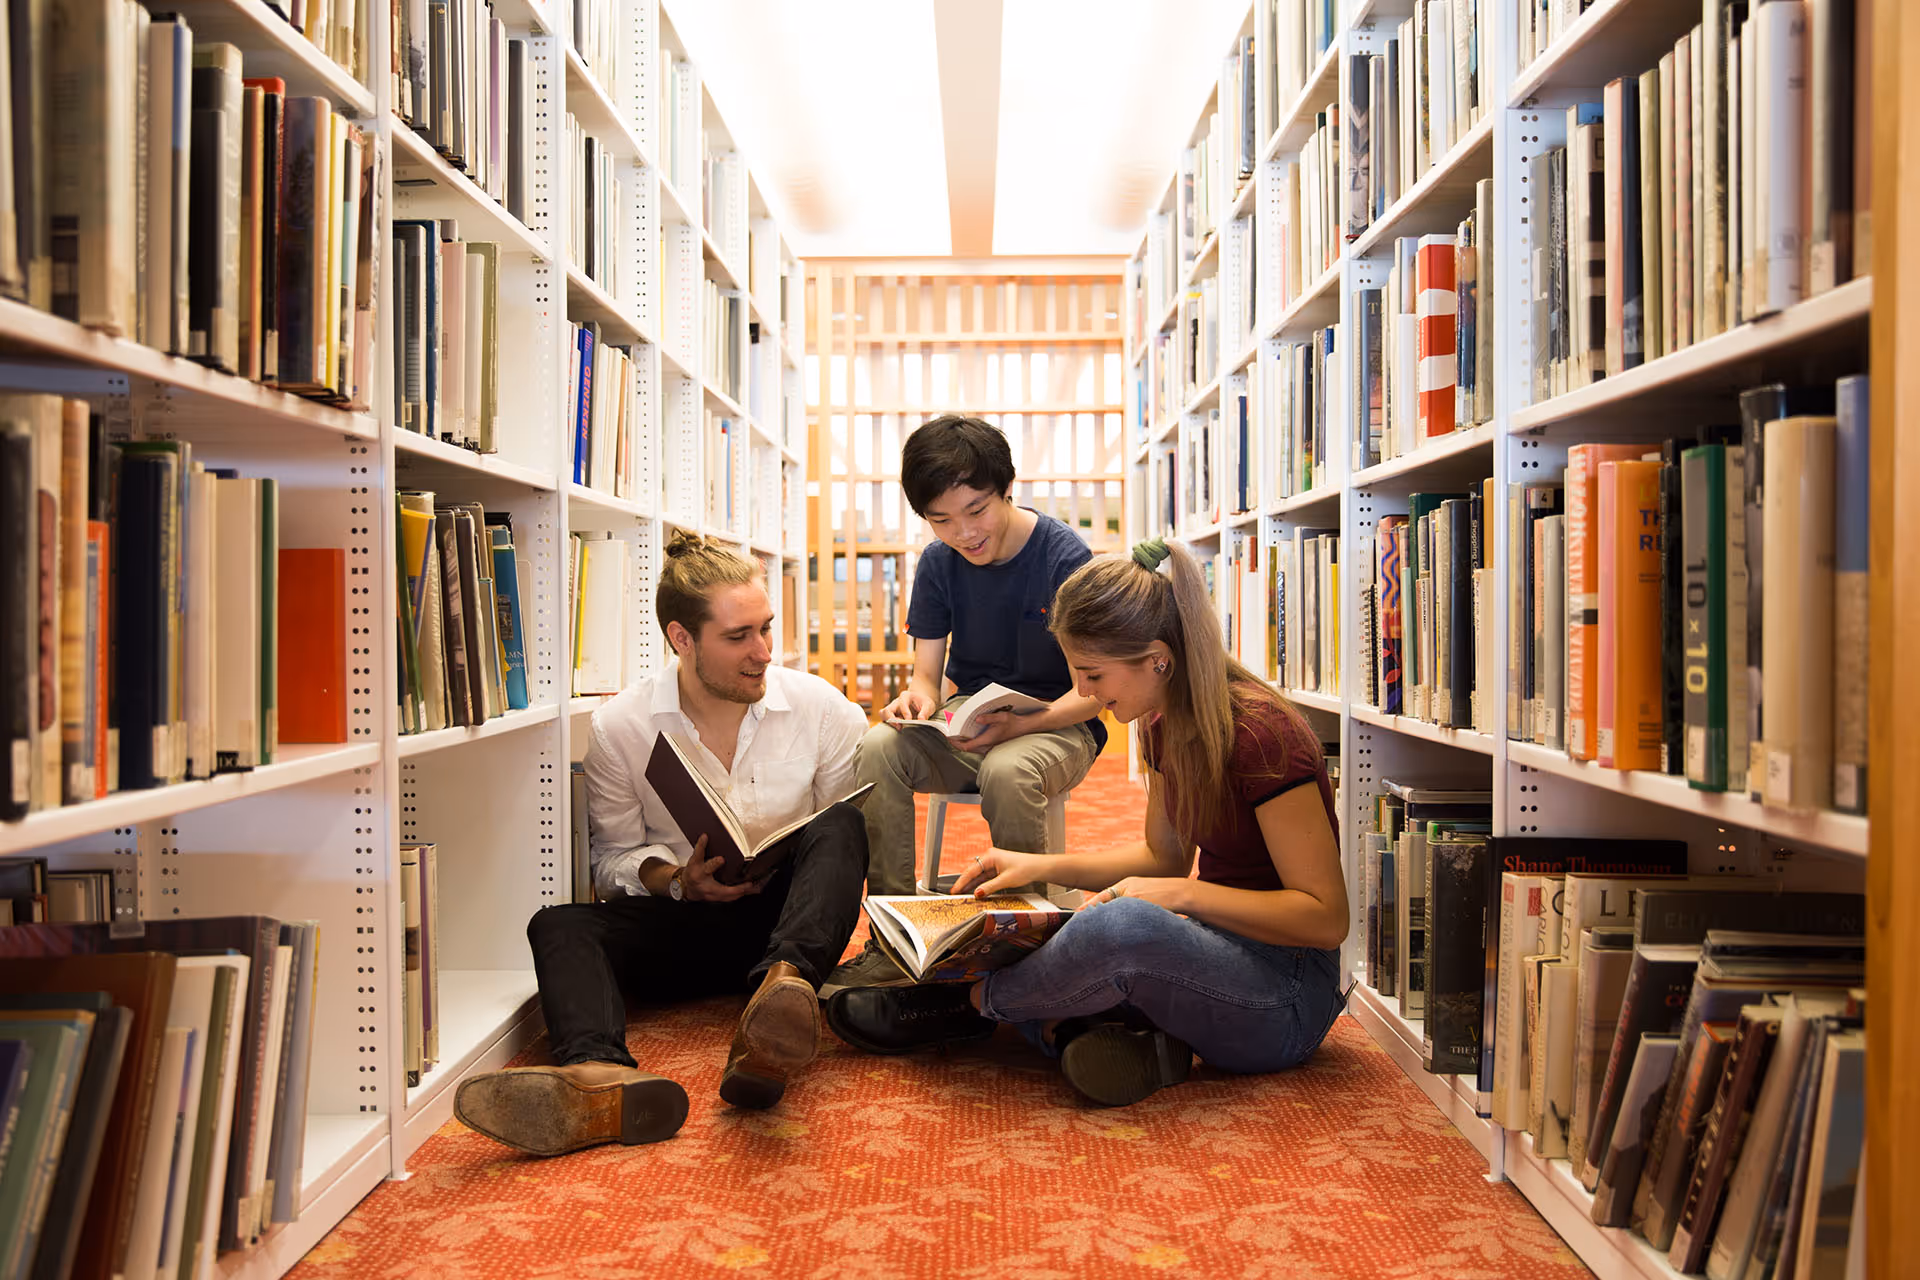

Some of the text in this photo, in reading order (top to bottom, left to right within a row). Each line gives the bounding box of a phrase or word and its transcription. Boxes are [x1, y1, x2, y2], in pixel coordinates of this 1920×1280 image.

[582, 365, 591, 440] GENZKEN
[1503, 855, 1562, 873] Shane
[1424, 860, 1432, 949] VERSAILLES
